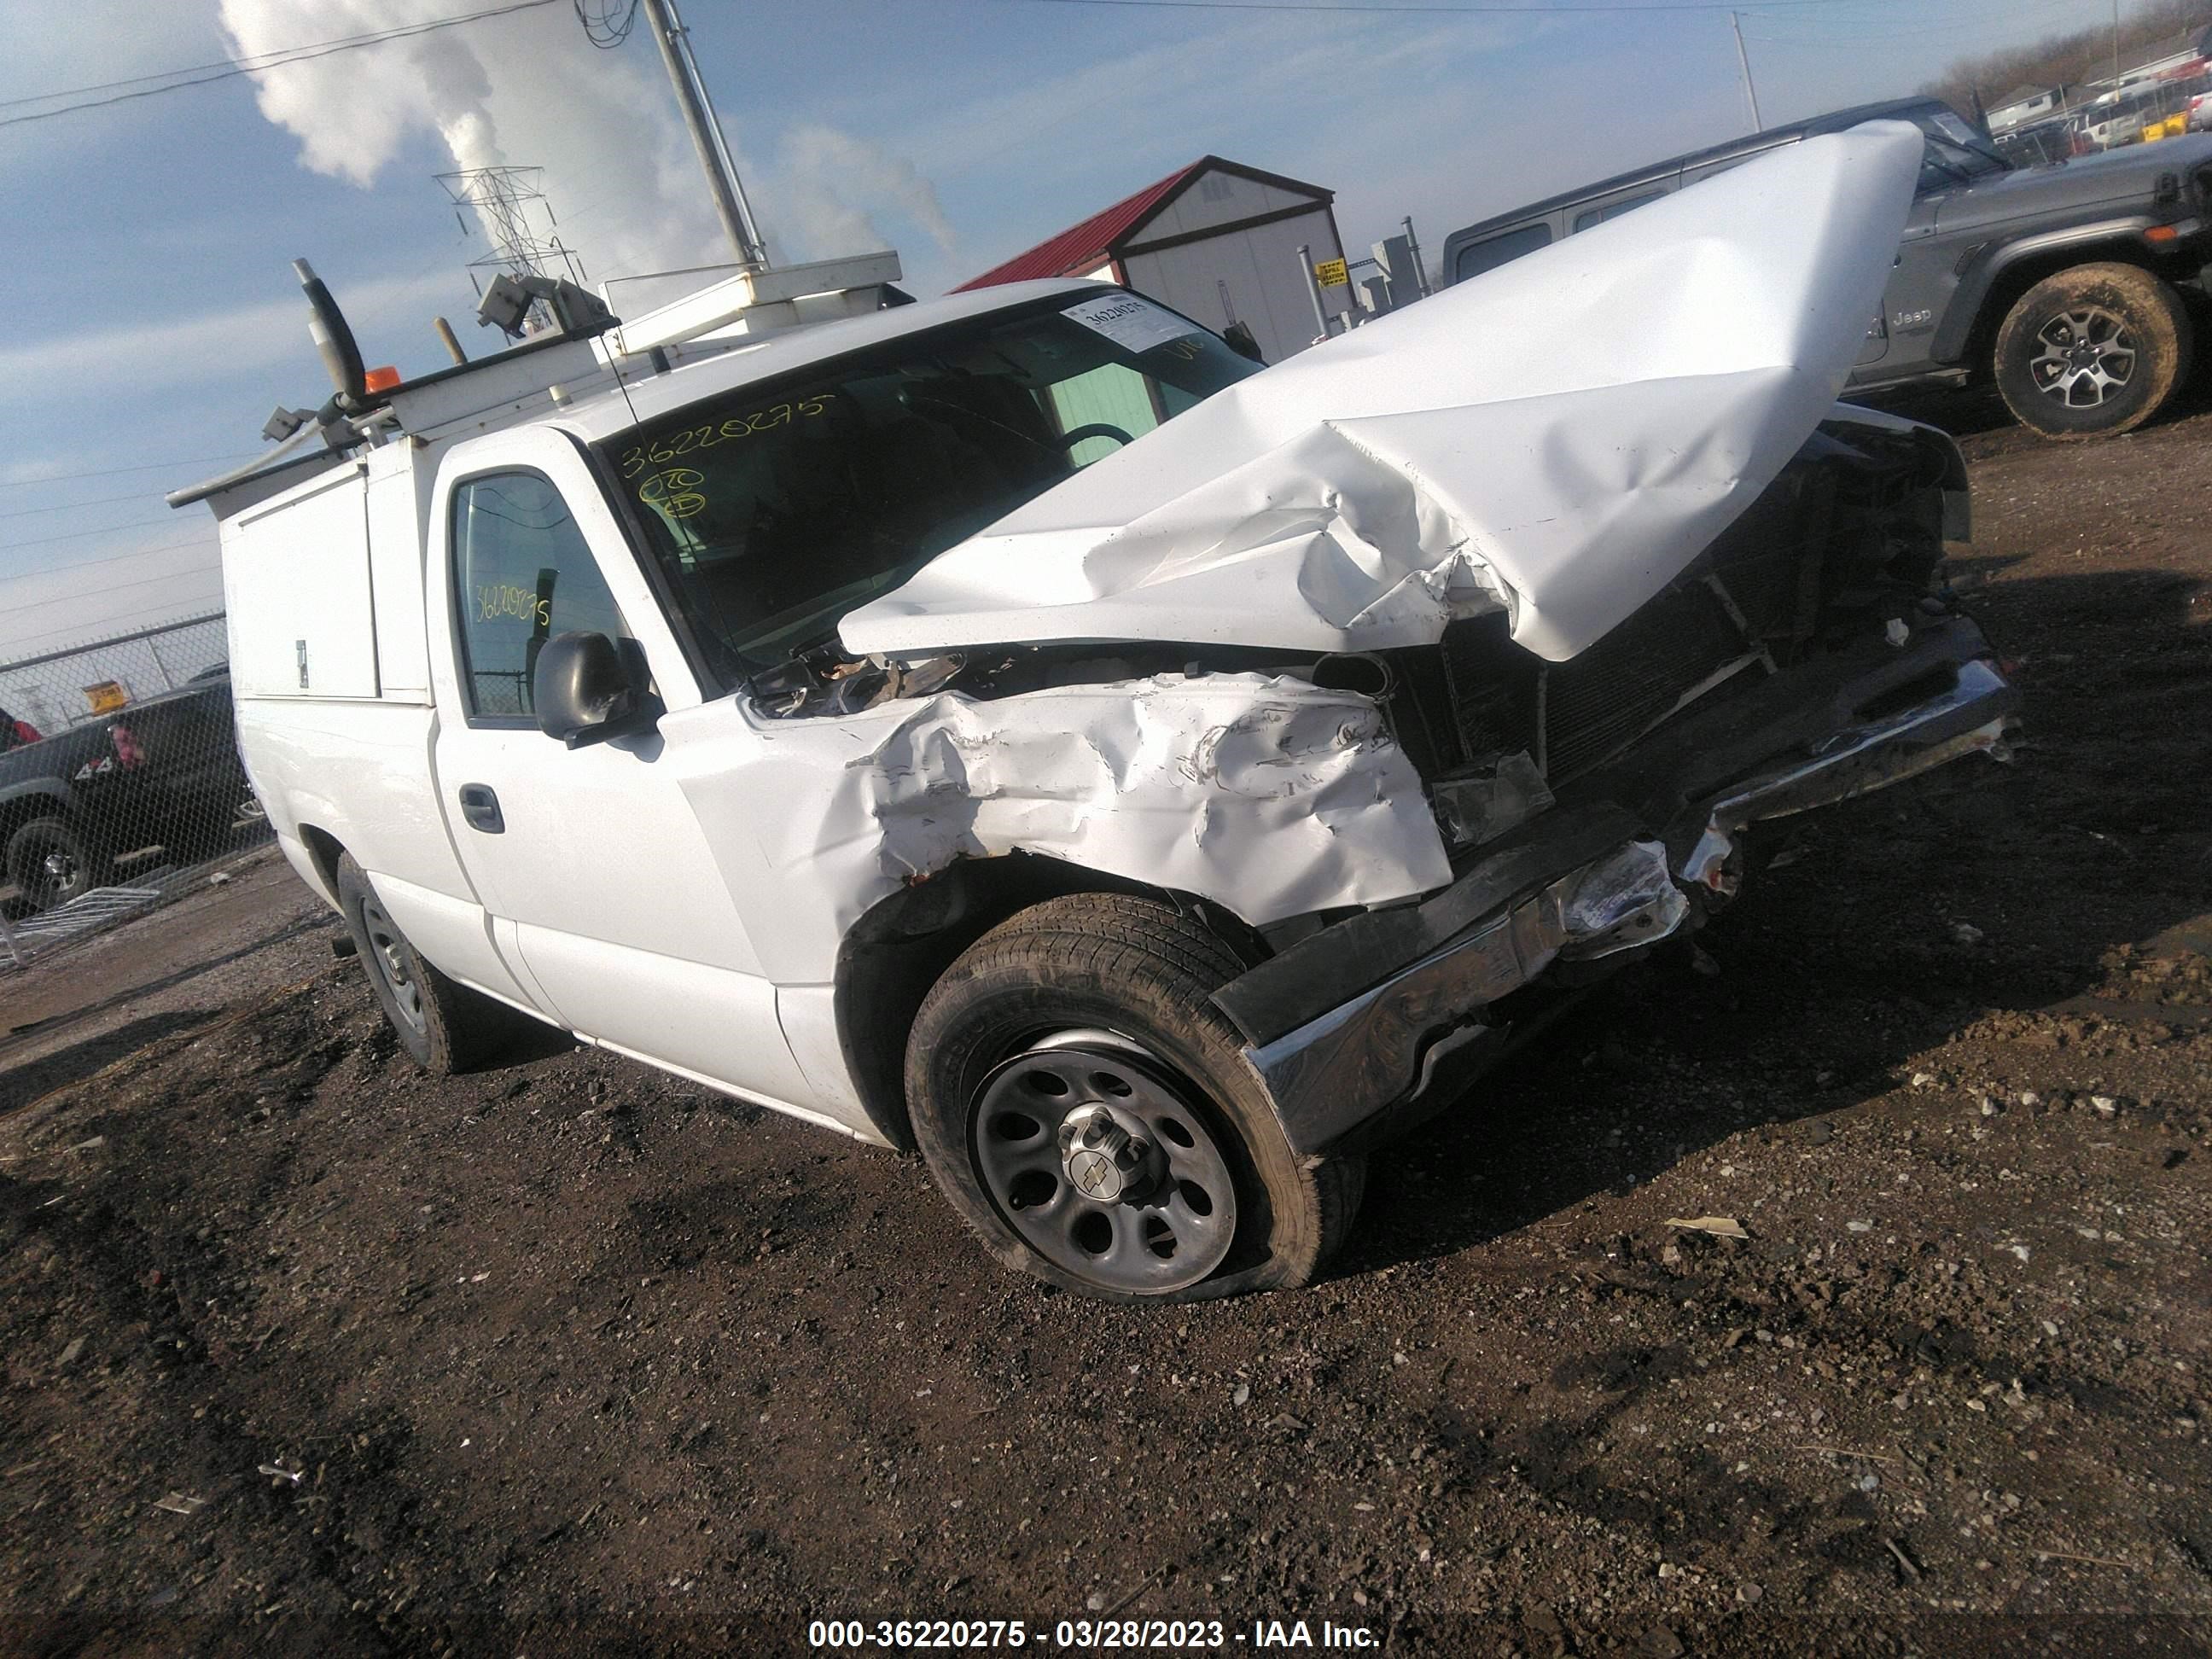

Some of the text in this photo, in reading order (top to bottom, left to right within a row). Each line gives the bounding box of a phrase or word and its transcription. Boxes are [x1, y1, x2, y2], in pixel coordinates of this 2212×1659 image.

[1086, 301, 1148, 325] 36220275
[1893, 309, 1932, 326] Jeep
[621, 394, 835, 479] 36220275
